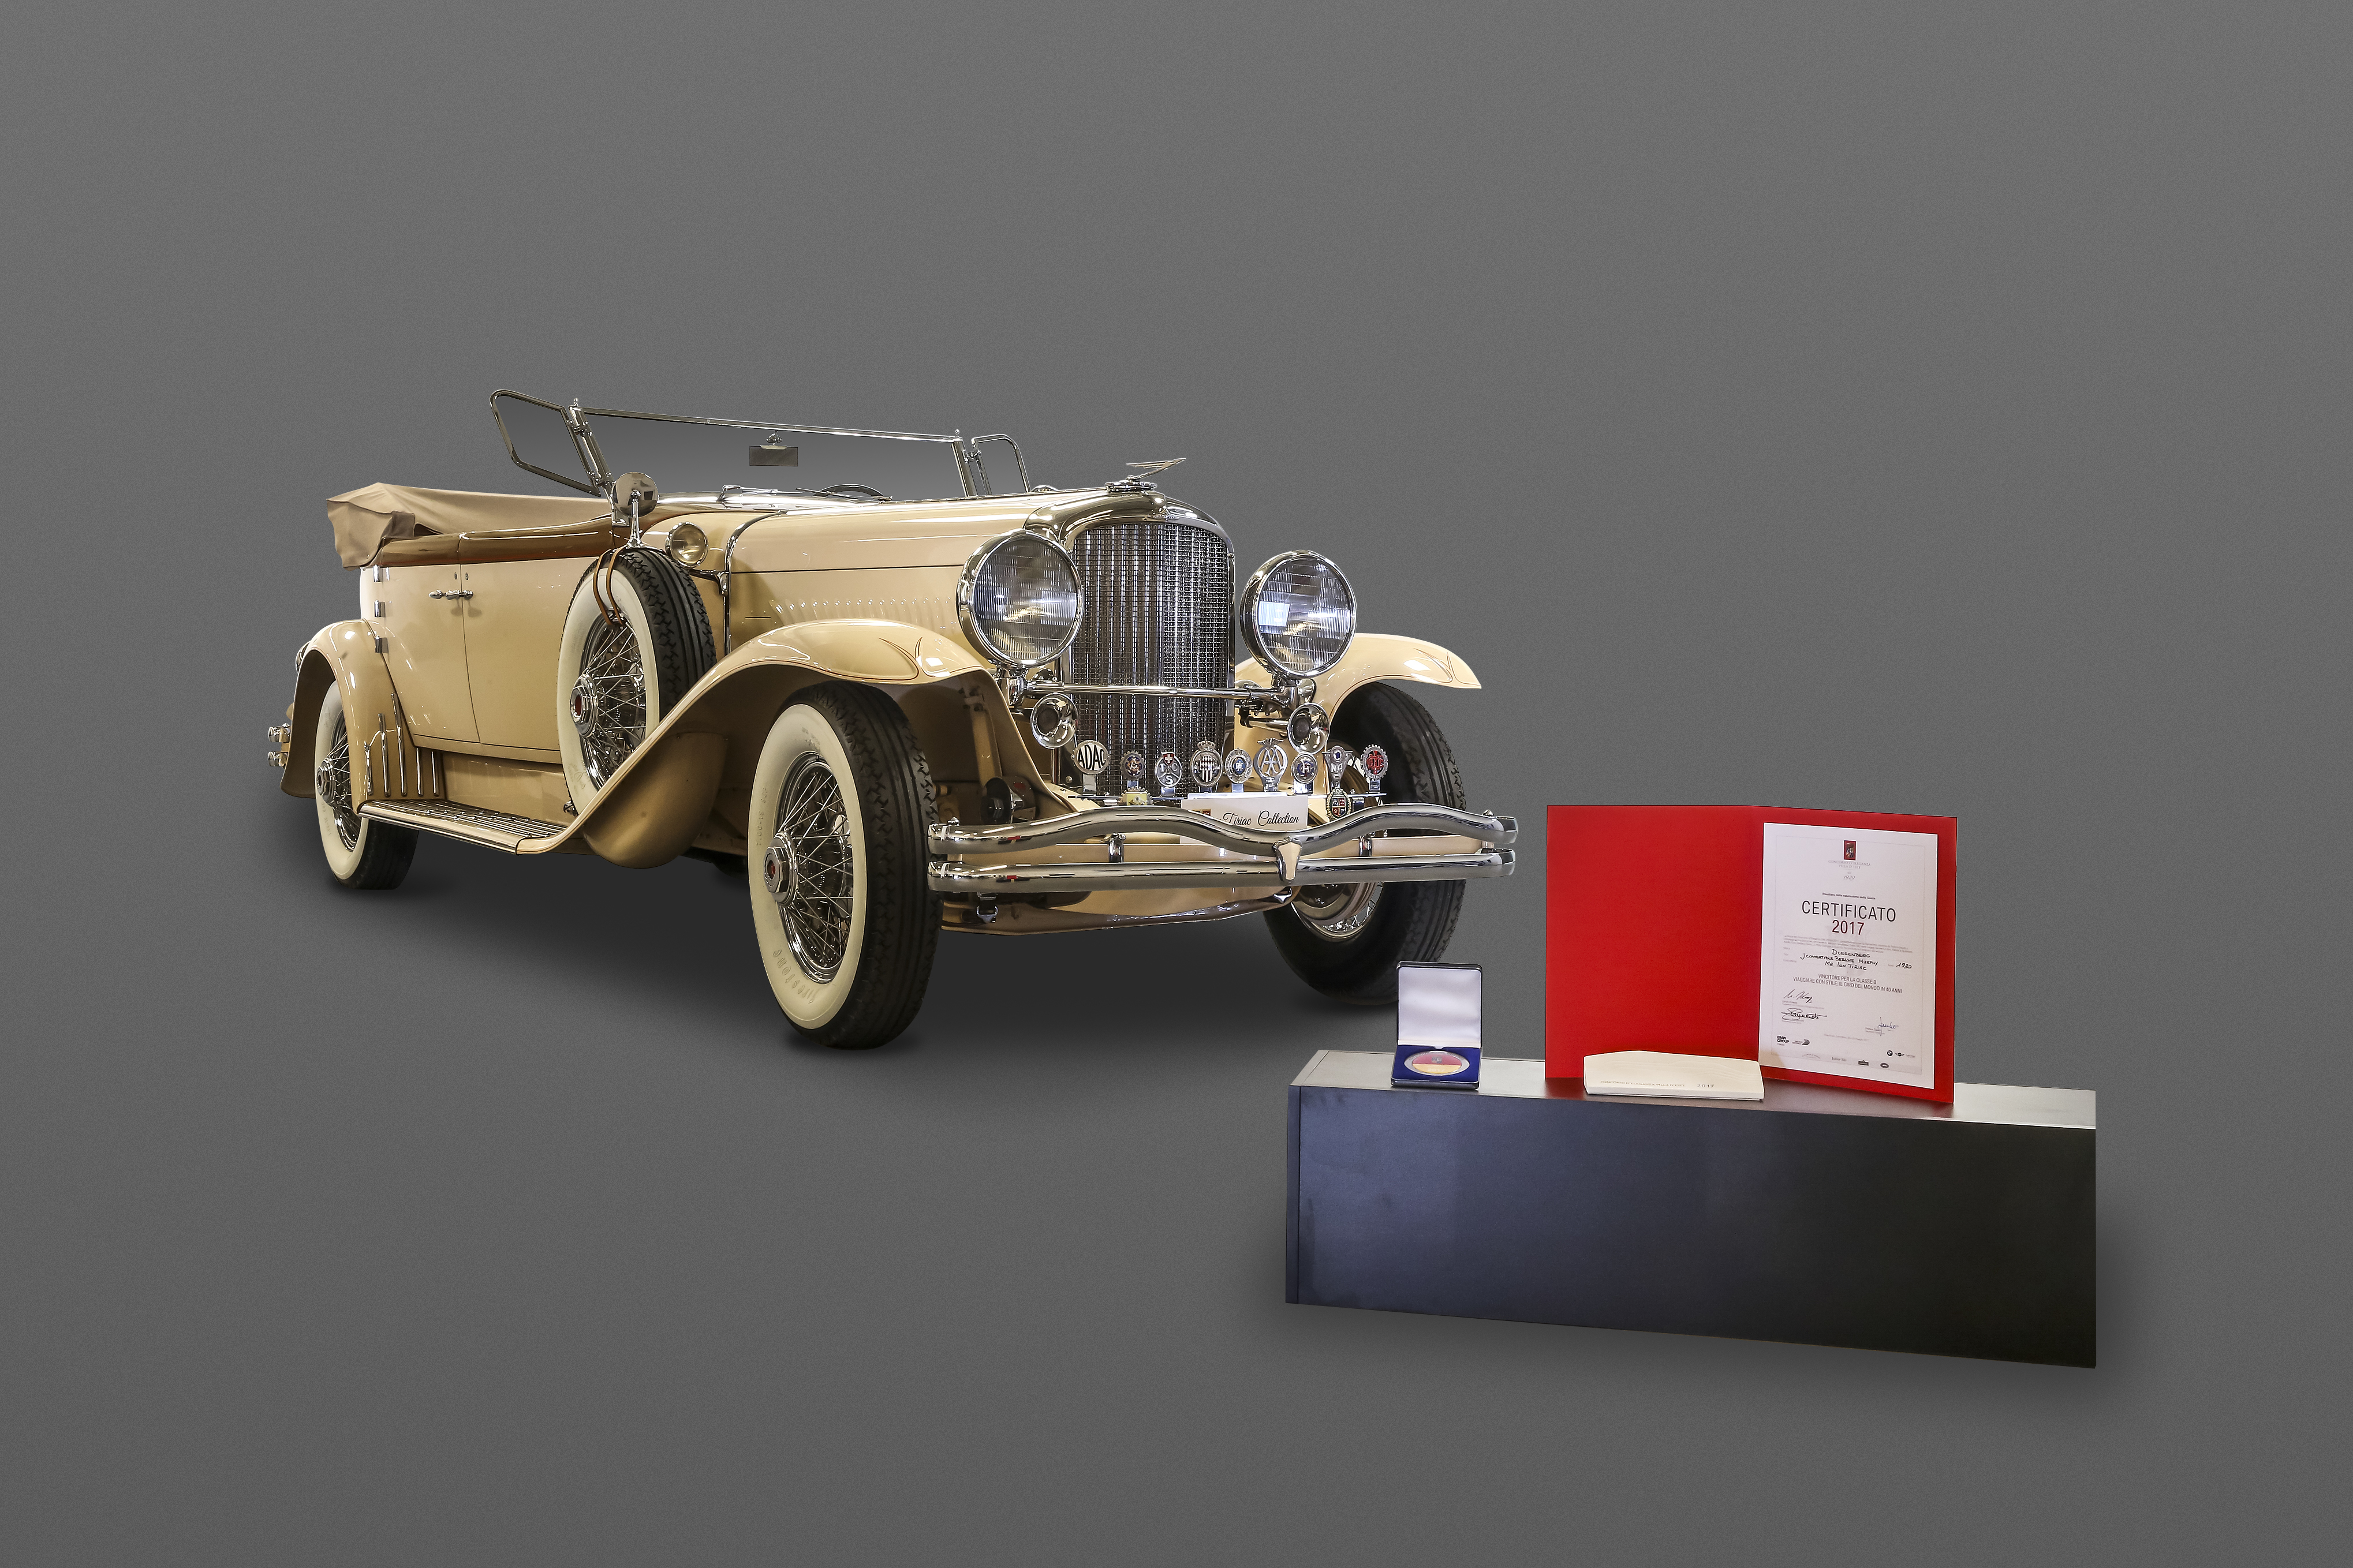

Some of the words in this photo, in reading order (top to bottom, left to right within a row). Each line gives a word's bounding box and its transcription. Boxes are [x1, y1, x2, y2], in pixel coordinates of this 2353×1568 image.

[1078, 744, 1106, 771] ADAC
[1223, 812, 1252, 826] Tiriac
[1258, 810, 1299, 826] Collection
[1802, 900, 1896, 922] CERTIFICATO
[1832, 919, 1865, 935] 2017
[1832, 948, 1870, 958] DUESENBERG
[1858, 959, 1878, 967] MURPHY
